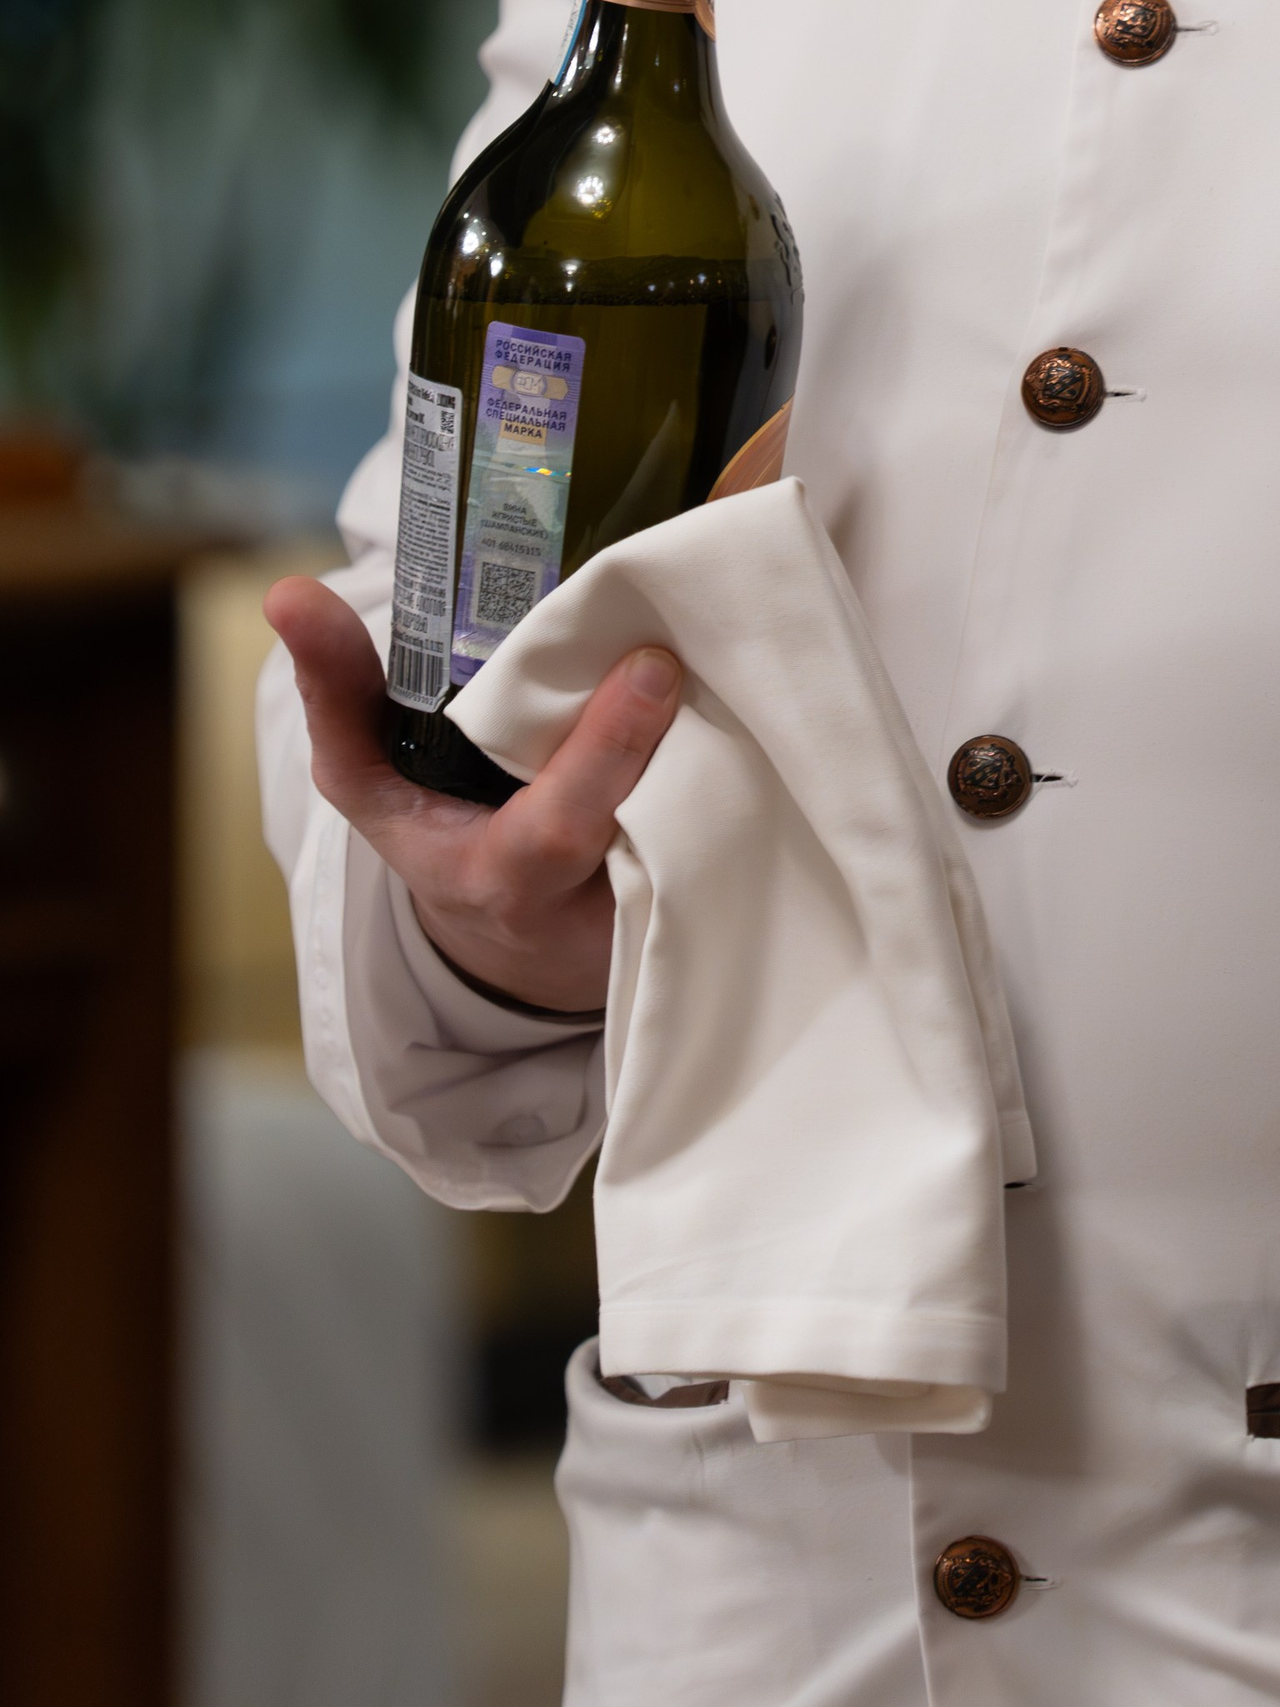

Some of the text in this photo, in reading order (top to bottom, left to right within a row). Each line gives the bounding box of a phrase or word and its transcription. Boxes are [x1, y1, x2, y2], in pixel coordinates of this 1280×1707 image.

[495, 350, 571, 373] ФЕДЕРАЦИЯ
[496, 339, 572, 362] РОССИЙСКАЯ
[486, 408, 567, 432] СПЕЦИАЛЬНАЯ
[487, 397, 568, 420] ФЕДЕРАЛЬНАЯ
[504, 423, 543, 439] МАРКА
